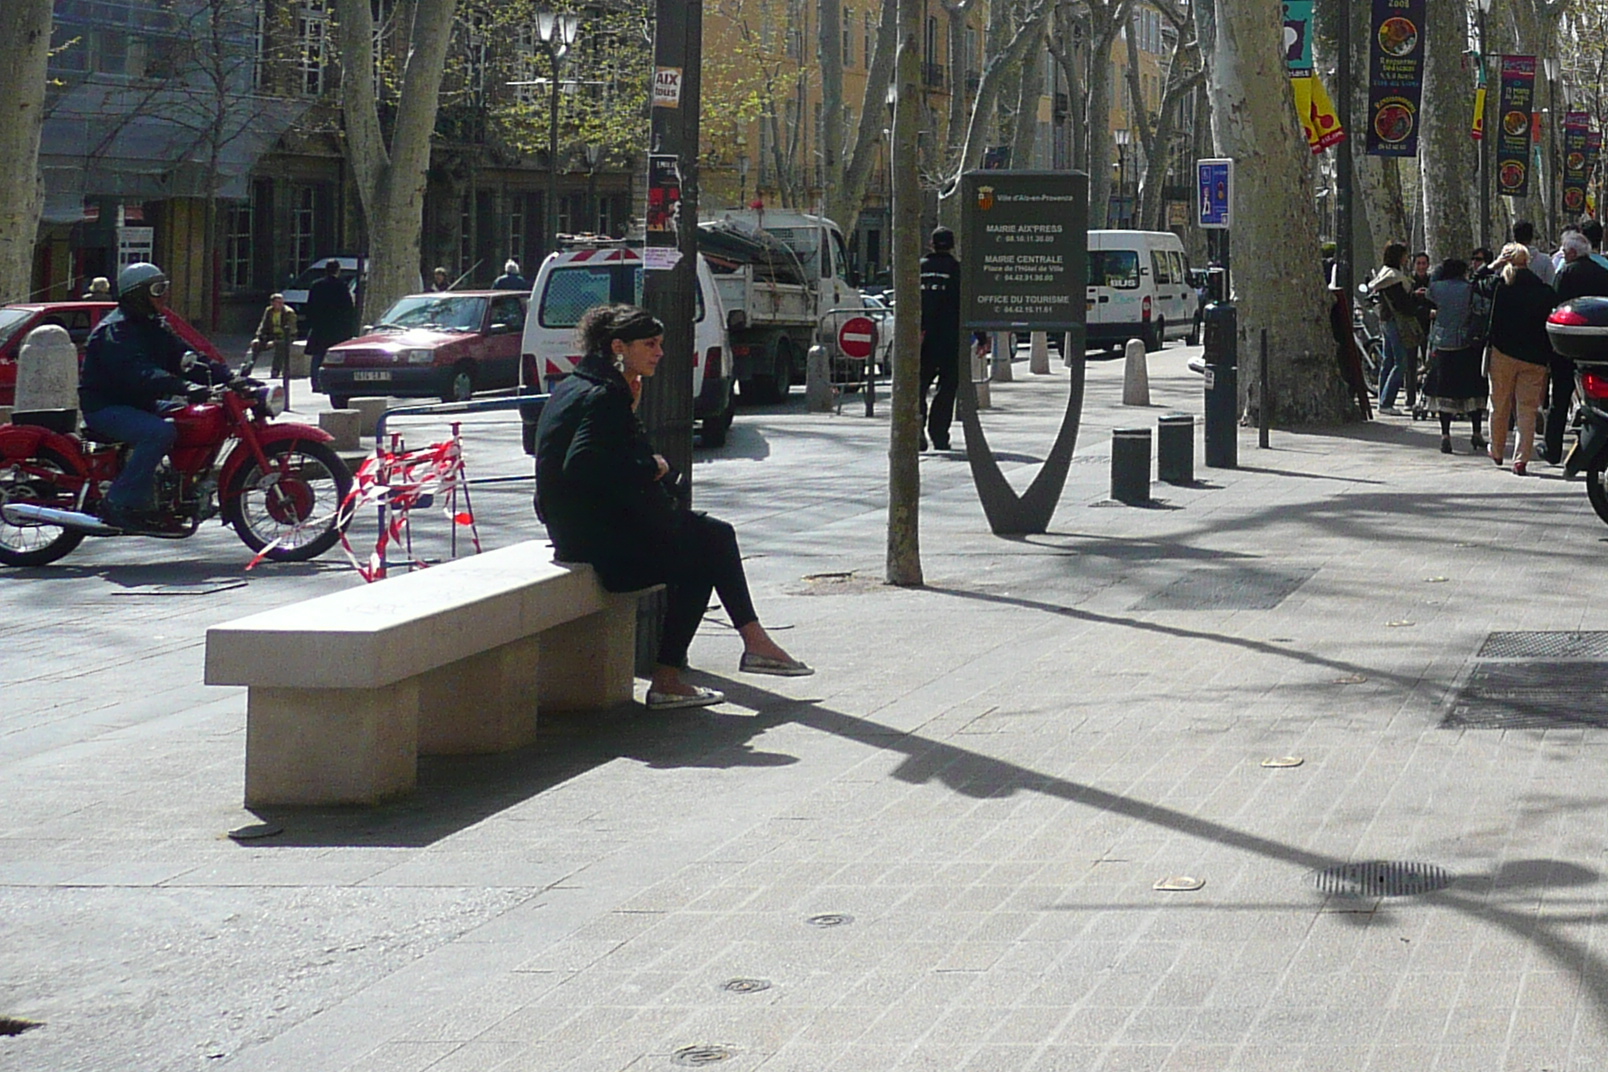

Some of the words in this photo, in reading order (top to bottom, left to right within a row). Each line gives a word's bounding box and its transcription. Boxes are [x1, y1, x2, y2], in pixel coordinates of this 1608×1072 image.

[656, 73, 678, 86] AIX
[986, 224, 1016, 233] MAIRIE
[984, 255, 1015, 264] MAIRIE
[1016, 255, 1063, 264] CENTRALE
[983, 264, 1003, 272] Place
[1004, 264, 1013, 272] de
[1038, 264, 1047, 272] de
[1048, 264, 1064, 272] Ville
[1110, 279, 1136, 287] BUS
[977, 295, 1009, 304] OFFICE
[1010, 295, 1023, 304] DU
[1025, 295, 1070, 304] TOURISME
